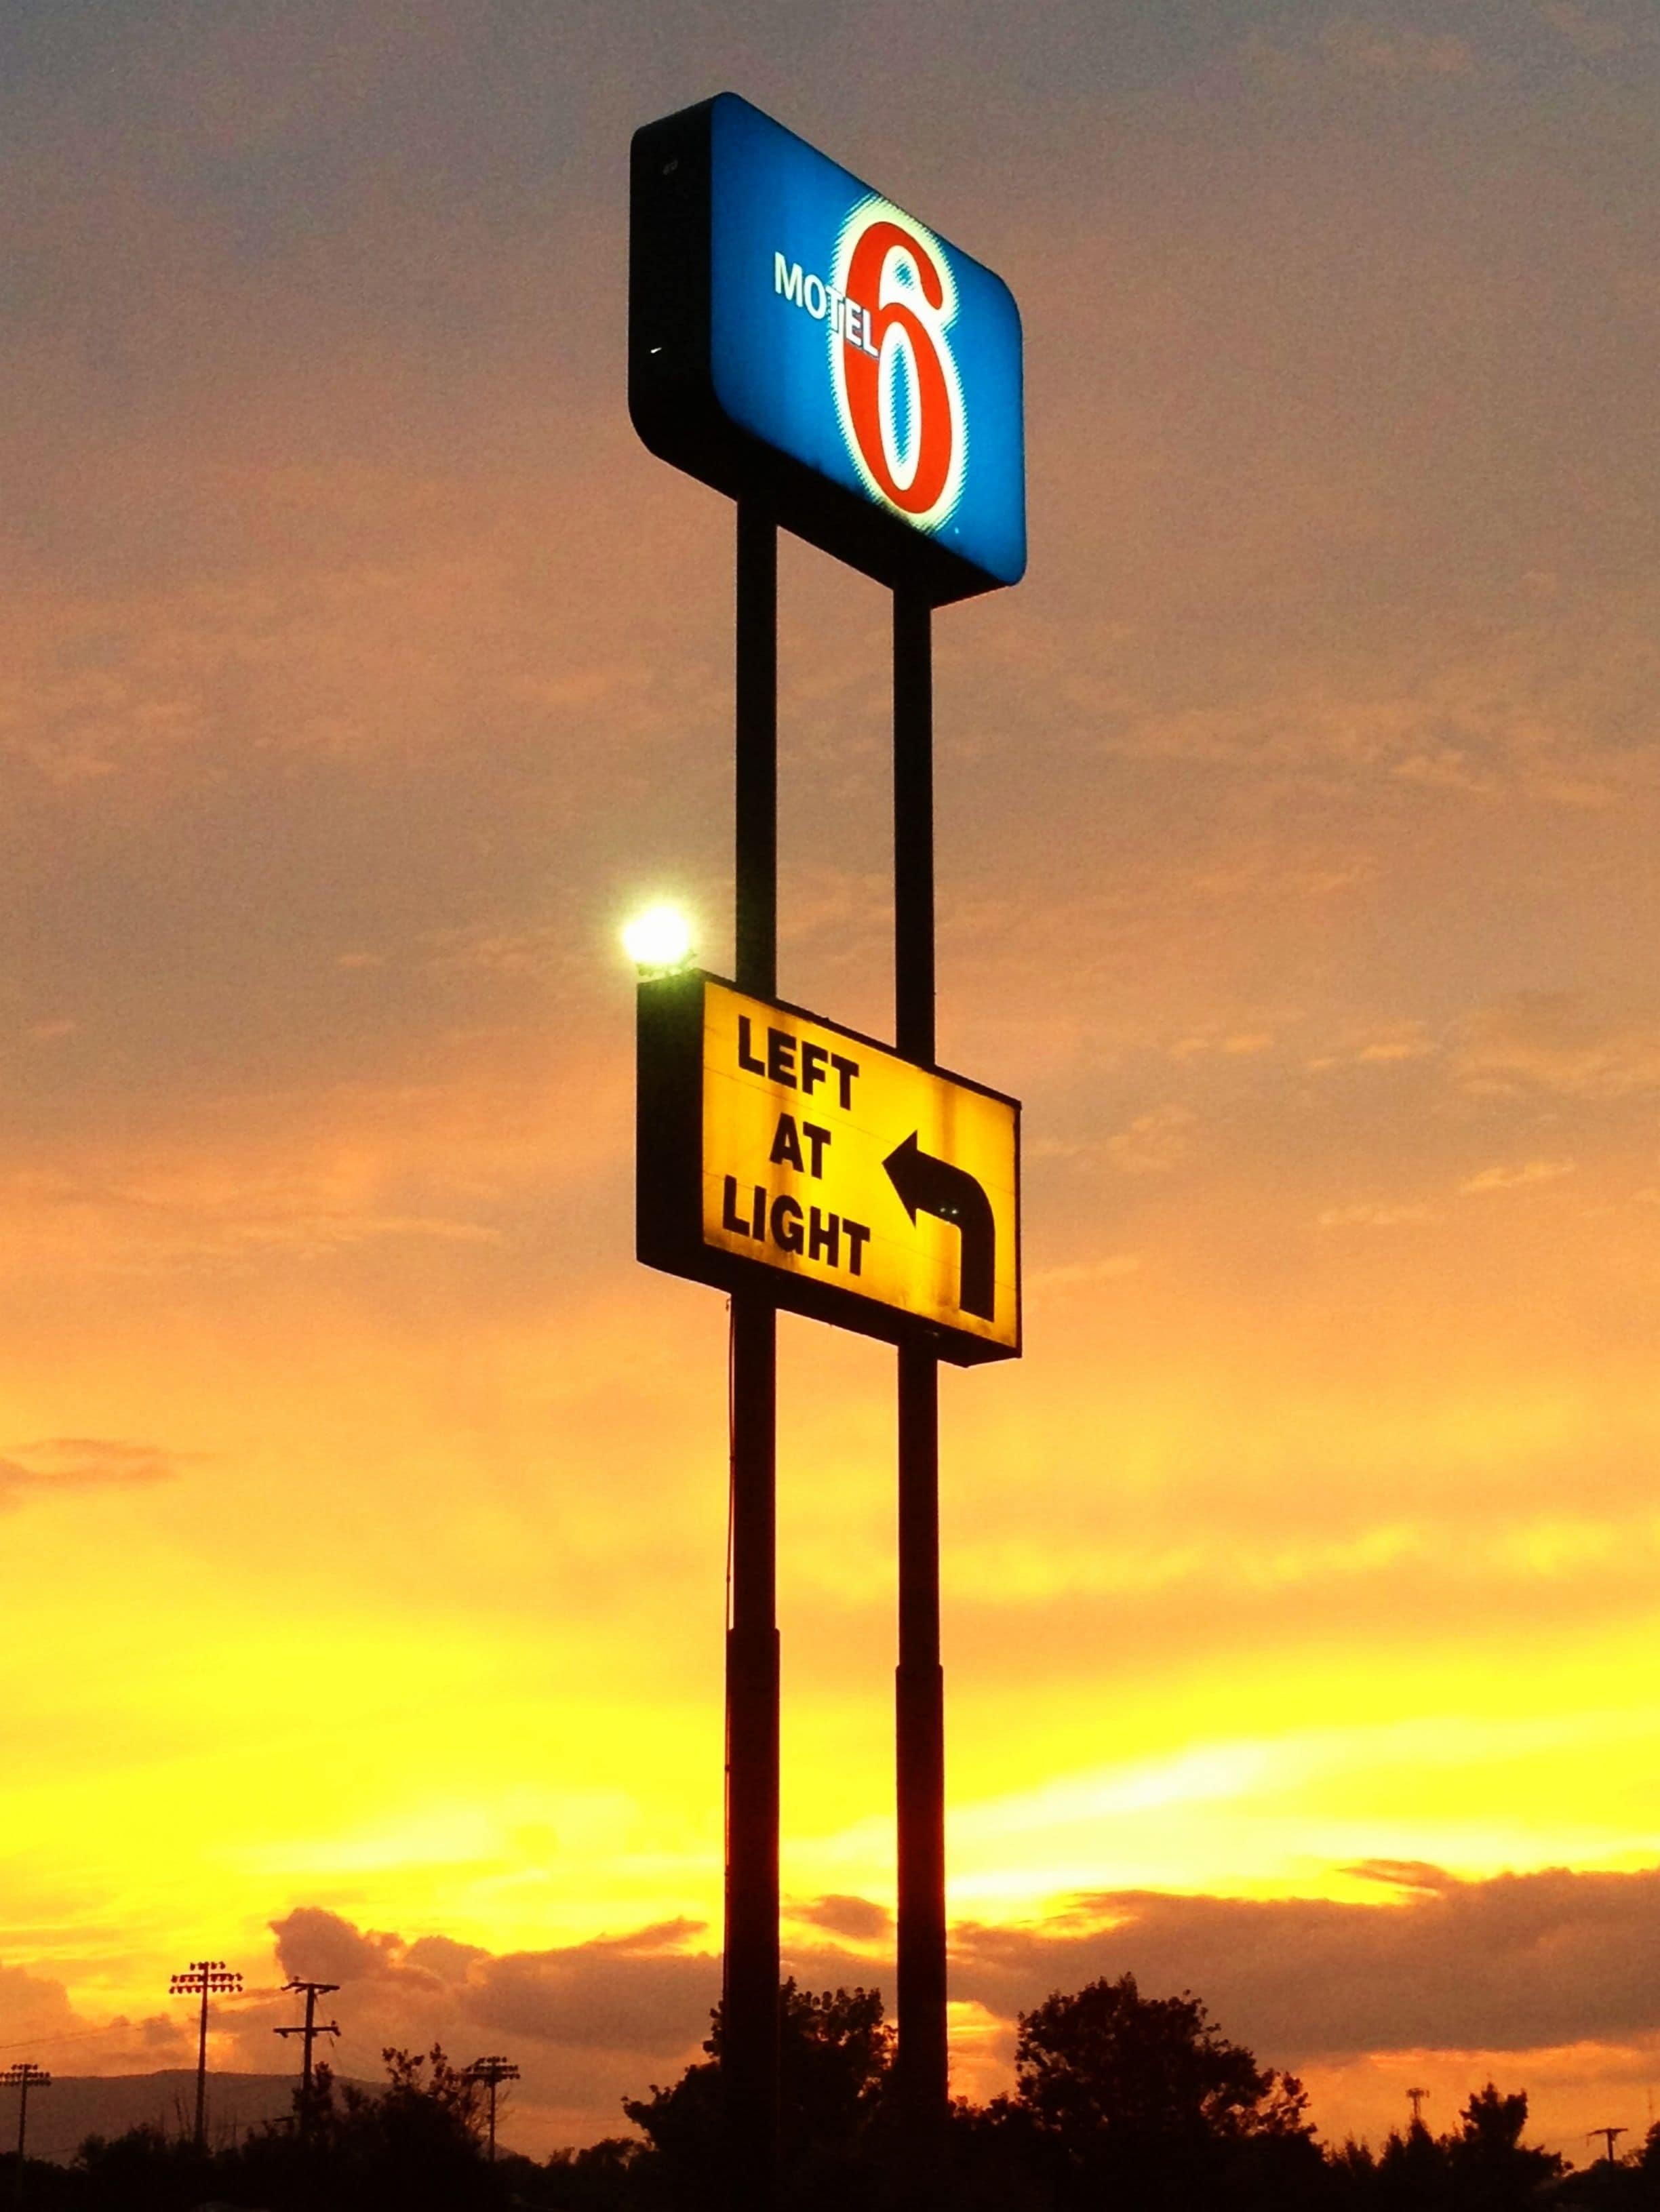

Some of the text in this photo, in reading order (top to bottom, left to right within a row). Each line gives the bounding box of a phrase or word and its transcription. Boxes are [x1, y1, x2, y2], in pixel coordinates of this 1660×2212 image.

[774, 218, 953, 516] MOTEL 6
[738, 1015, 859, 1111] LEFT
[769, 1112, 831, 1180] AT
[723, 1175, 870, 1276] LIGHT
